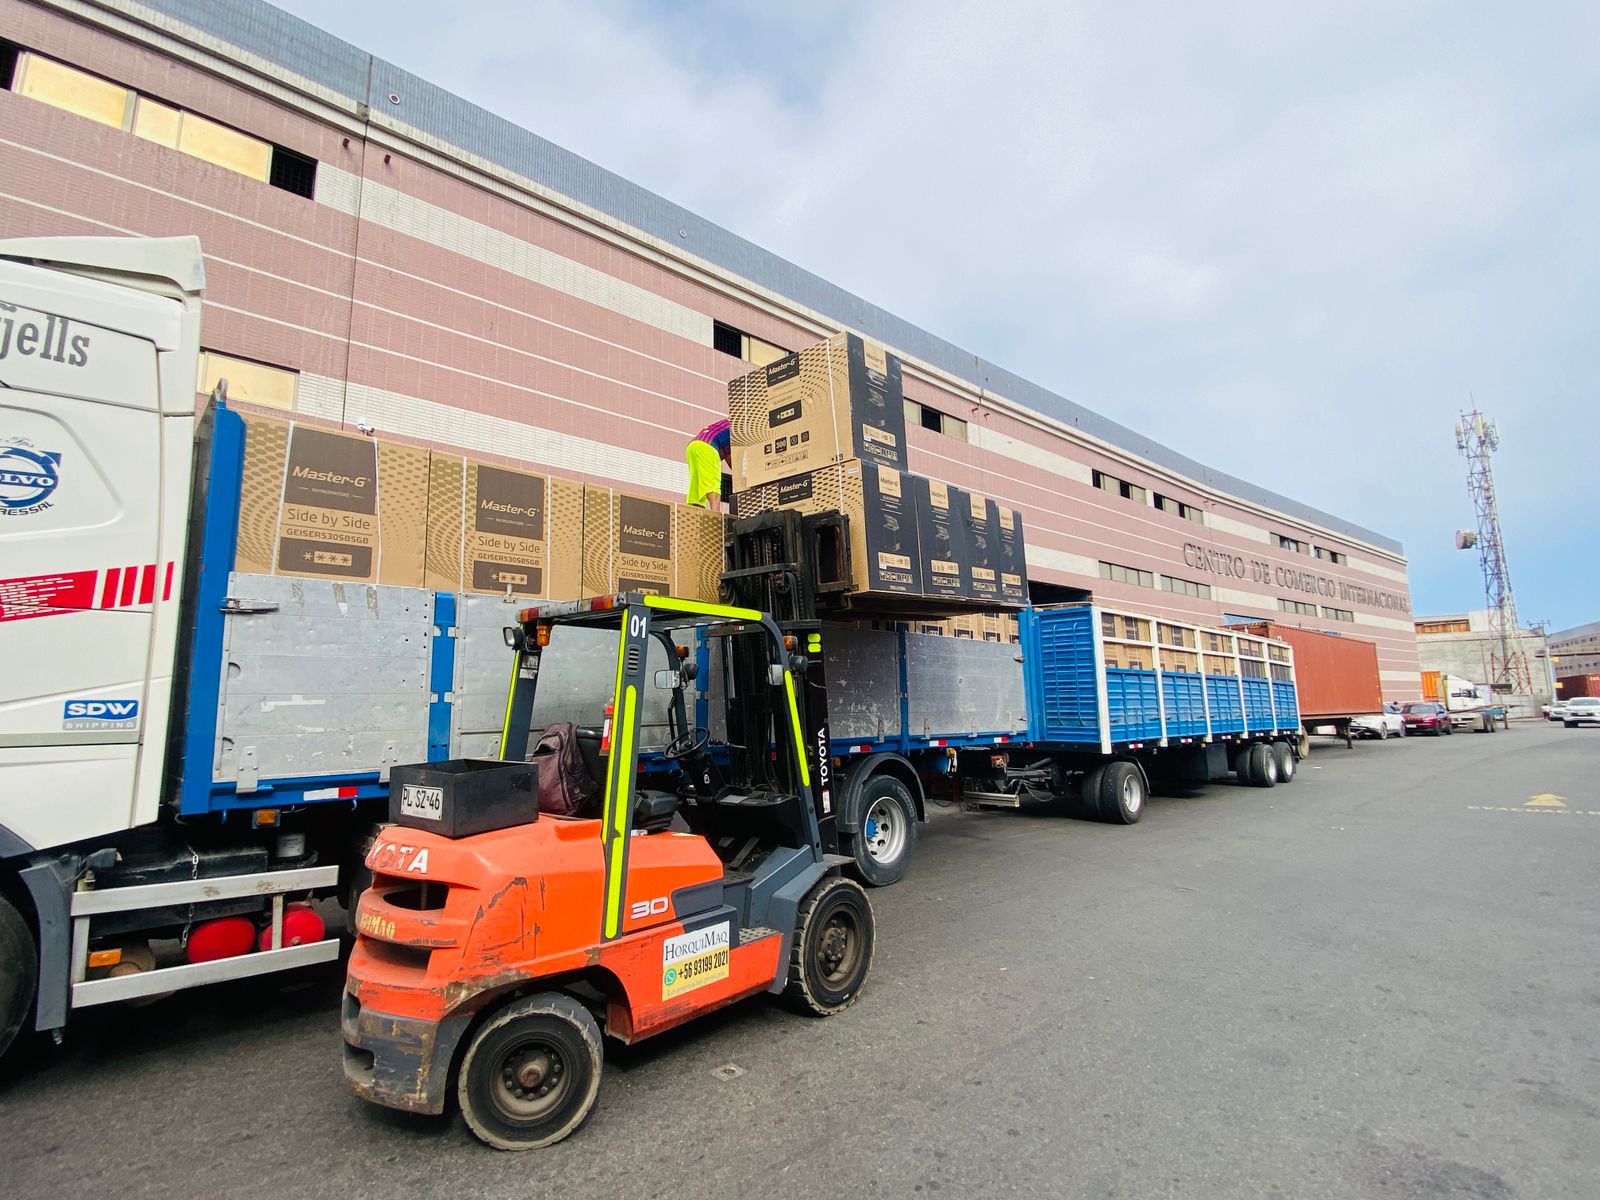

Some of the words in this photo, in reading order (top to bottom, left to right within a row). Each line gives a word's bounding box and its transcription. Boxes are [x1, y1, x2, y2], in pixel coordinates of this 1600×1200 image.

[769, 358, 797, 375] Master-G
[0, 473, 54, 487] LVO
[292, 466, 367, 488] Master-G
[780, 480, 808, 493] Master-G
[481, 499, 536, 517] Master-G
[287, 508, 318, 523] Side
[322, 513, 338, 528] by
[342, 516, 370, 530] Side
[623, 524, 665, 540] Master-G
[478, 535, 501, 548] Side
[504, 540, 516, 552] by
[520, 541, 541, 554] Side
[621, 556, 639, 567] Side
[640, 559, 650, 569] by
[652, 561, 668, 571] Side
[1182, 541, 1245, 579] CENTRO
[1251, 560, 1271, 584] DE
[1275, 567, 1336, 598] COMERCIO
[1338, 582, 1410, 613] INTERNACIONAL
[630, 614, 647, 639] 01
[67, 702, 136, 716] SDW
[66, 721, 134, 729] SHIPPING
[818, 727, 829, 786] TOYOTA
[630, 896, 668, 919] 30
[678, 962, 692, 979] +56
[694, 955, 712, 976] 93199
[714, 950, 728, 969] 2021
